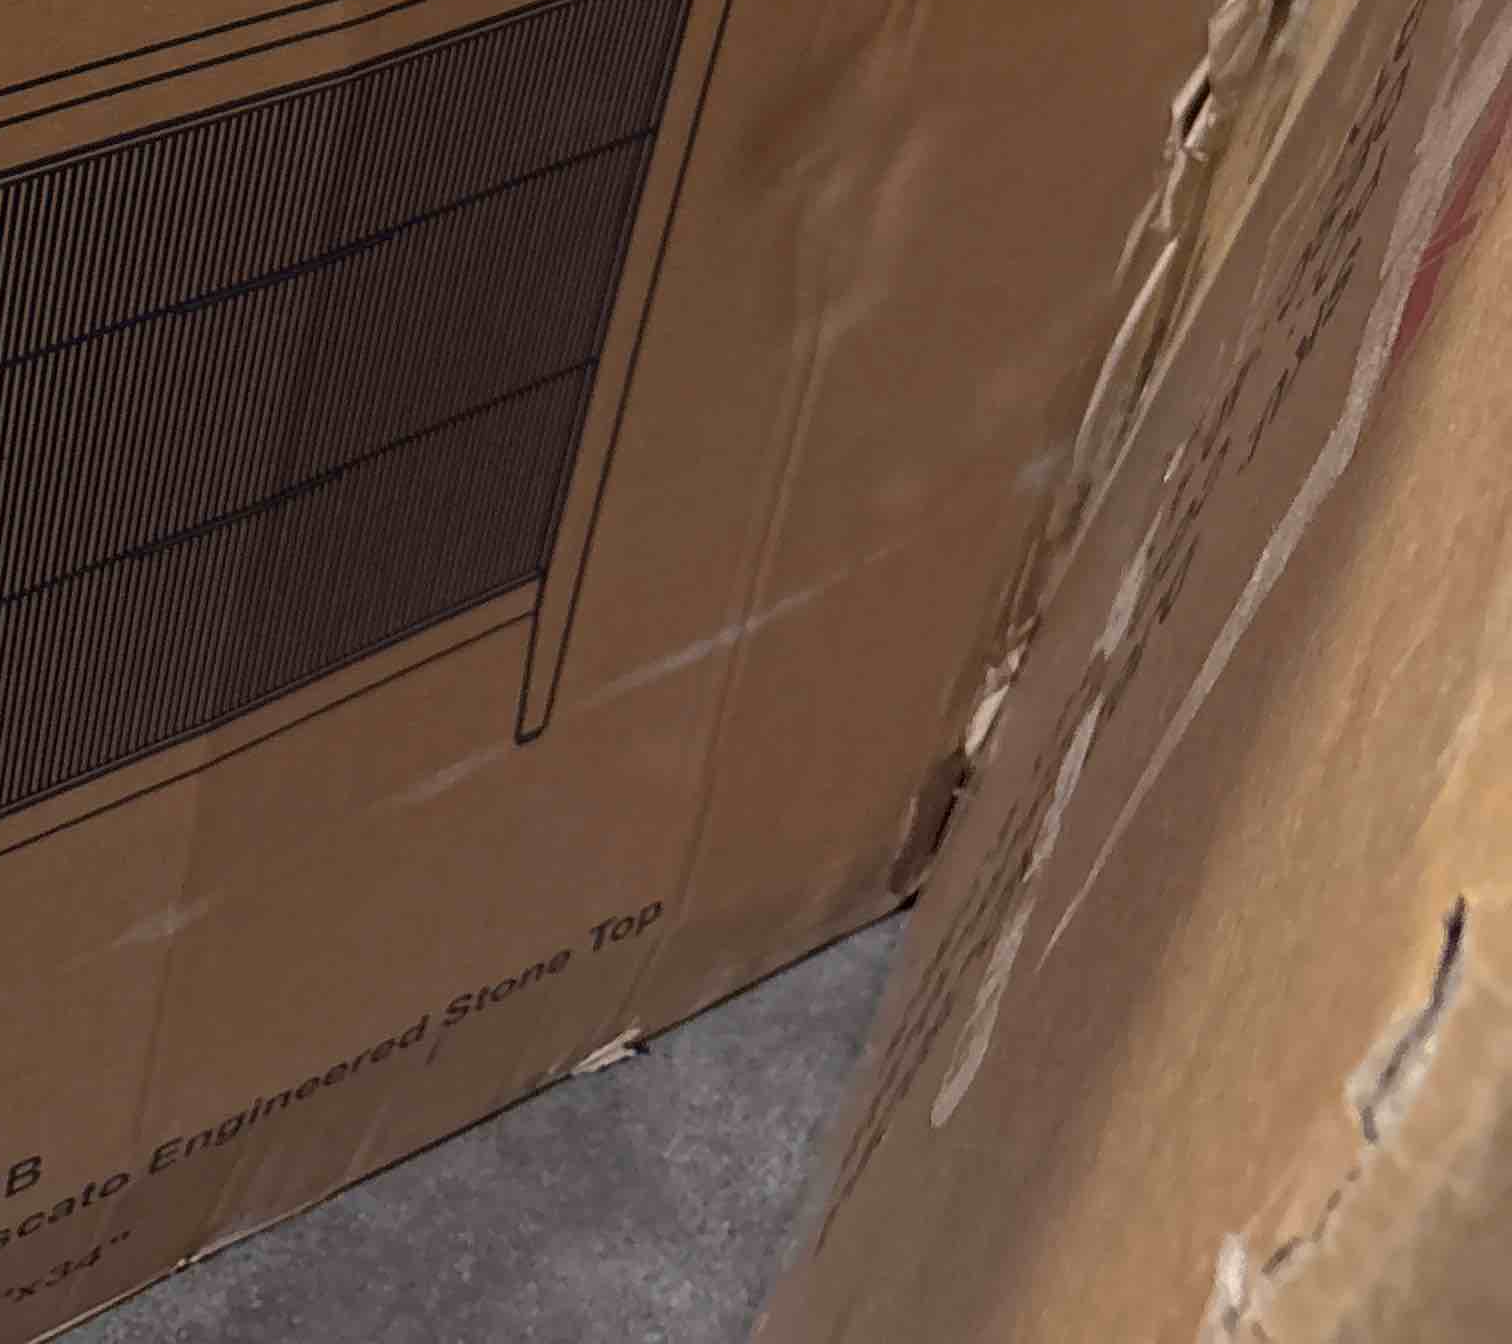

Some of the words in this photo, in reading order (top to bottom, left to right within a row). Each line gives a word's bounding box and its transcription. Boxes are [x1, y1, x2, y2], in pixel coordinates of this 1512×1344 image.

[148, 1015, 432, 1176] Engineered
[442, 948, 572, 1028] Stone
[589, 900, 665, 953] Top
